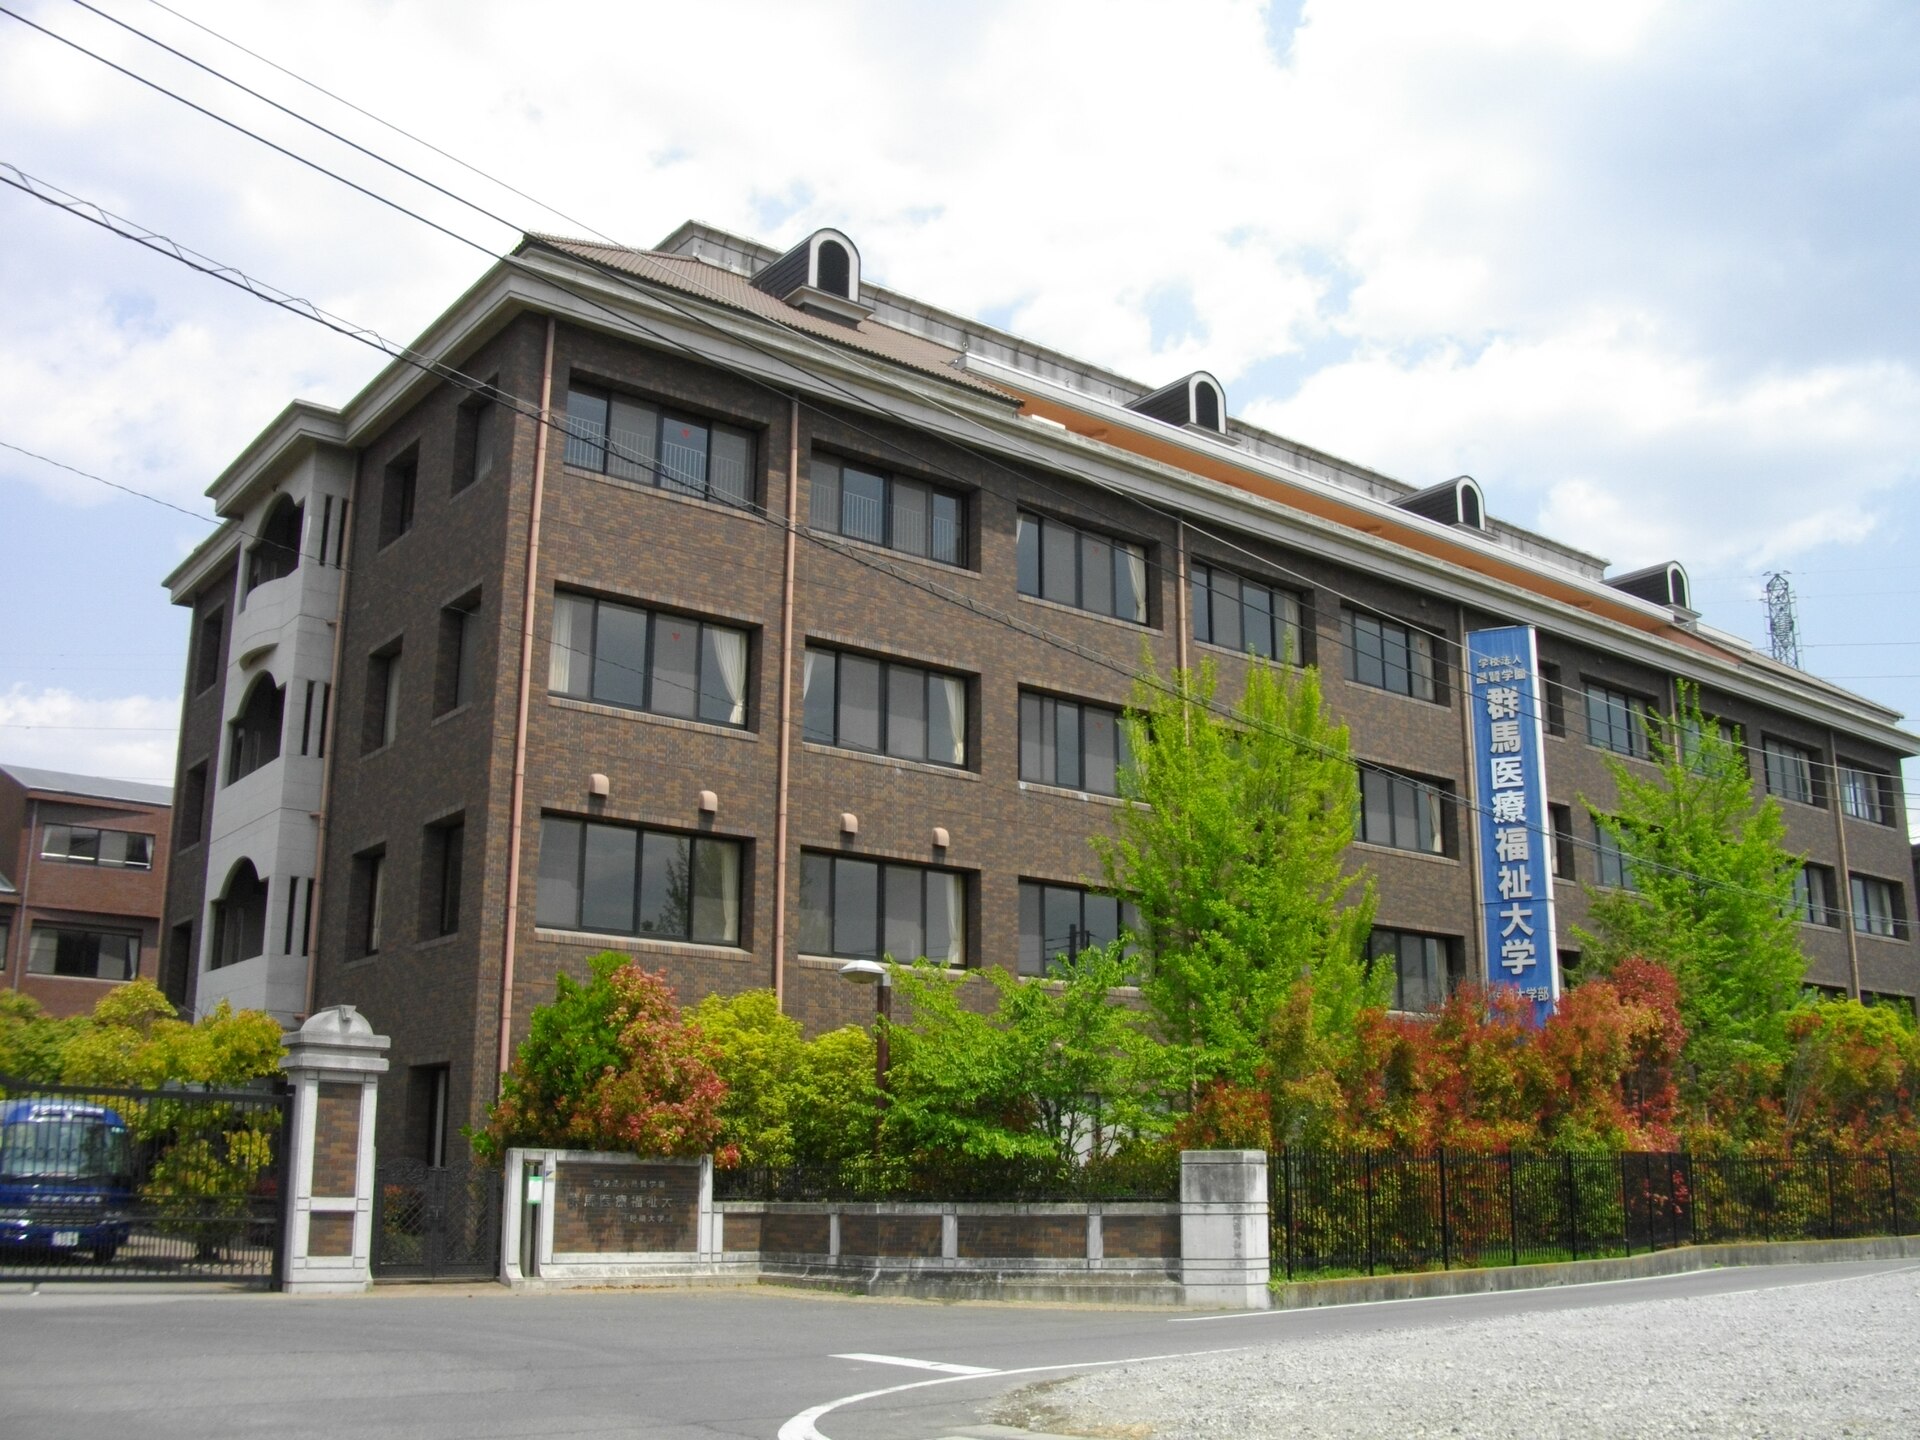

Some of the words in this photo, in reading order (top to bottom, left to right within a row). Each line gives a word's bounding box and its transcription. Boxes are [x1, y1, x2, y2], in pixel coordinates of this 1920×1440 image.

[1477, 654, 1522, 669] 学校法人
[1486, 686, 1537, 975] 群馬医療福祉大学
